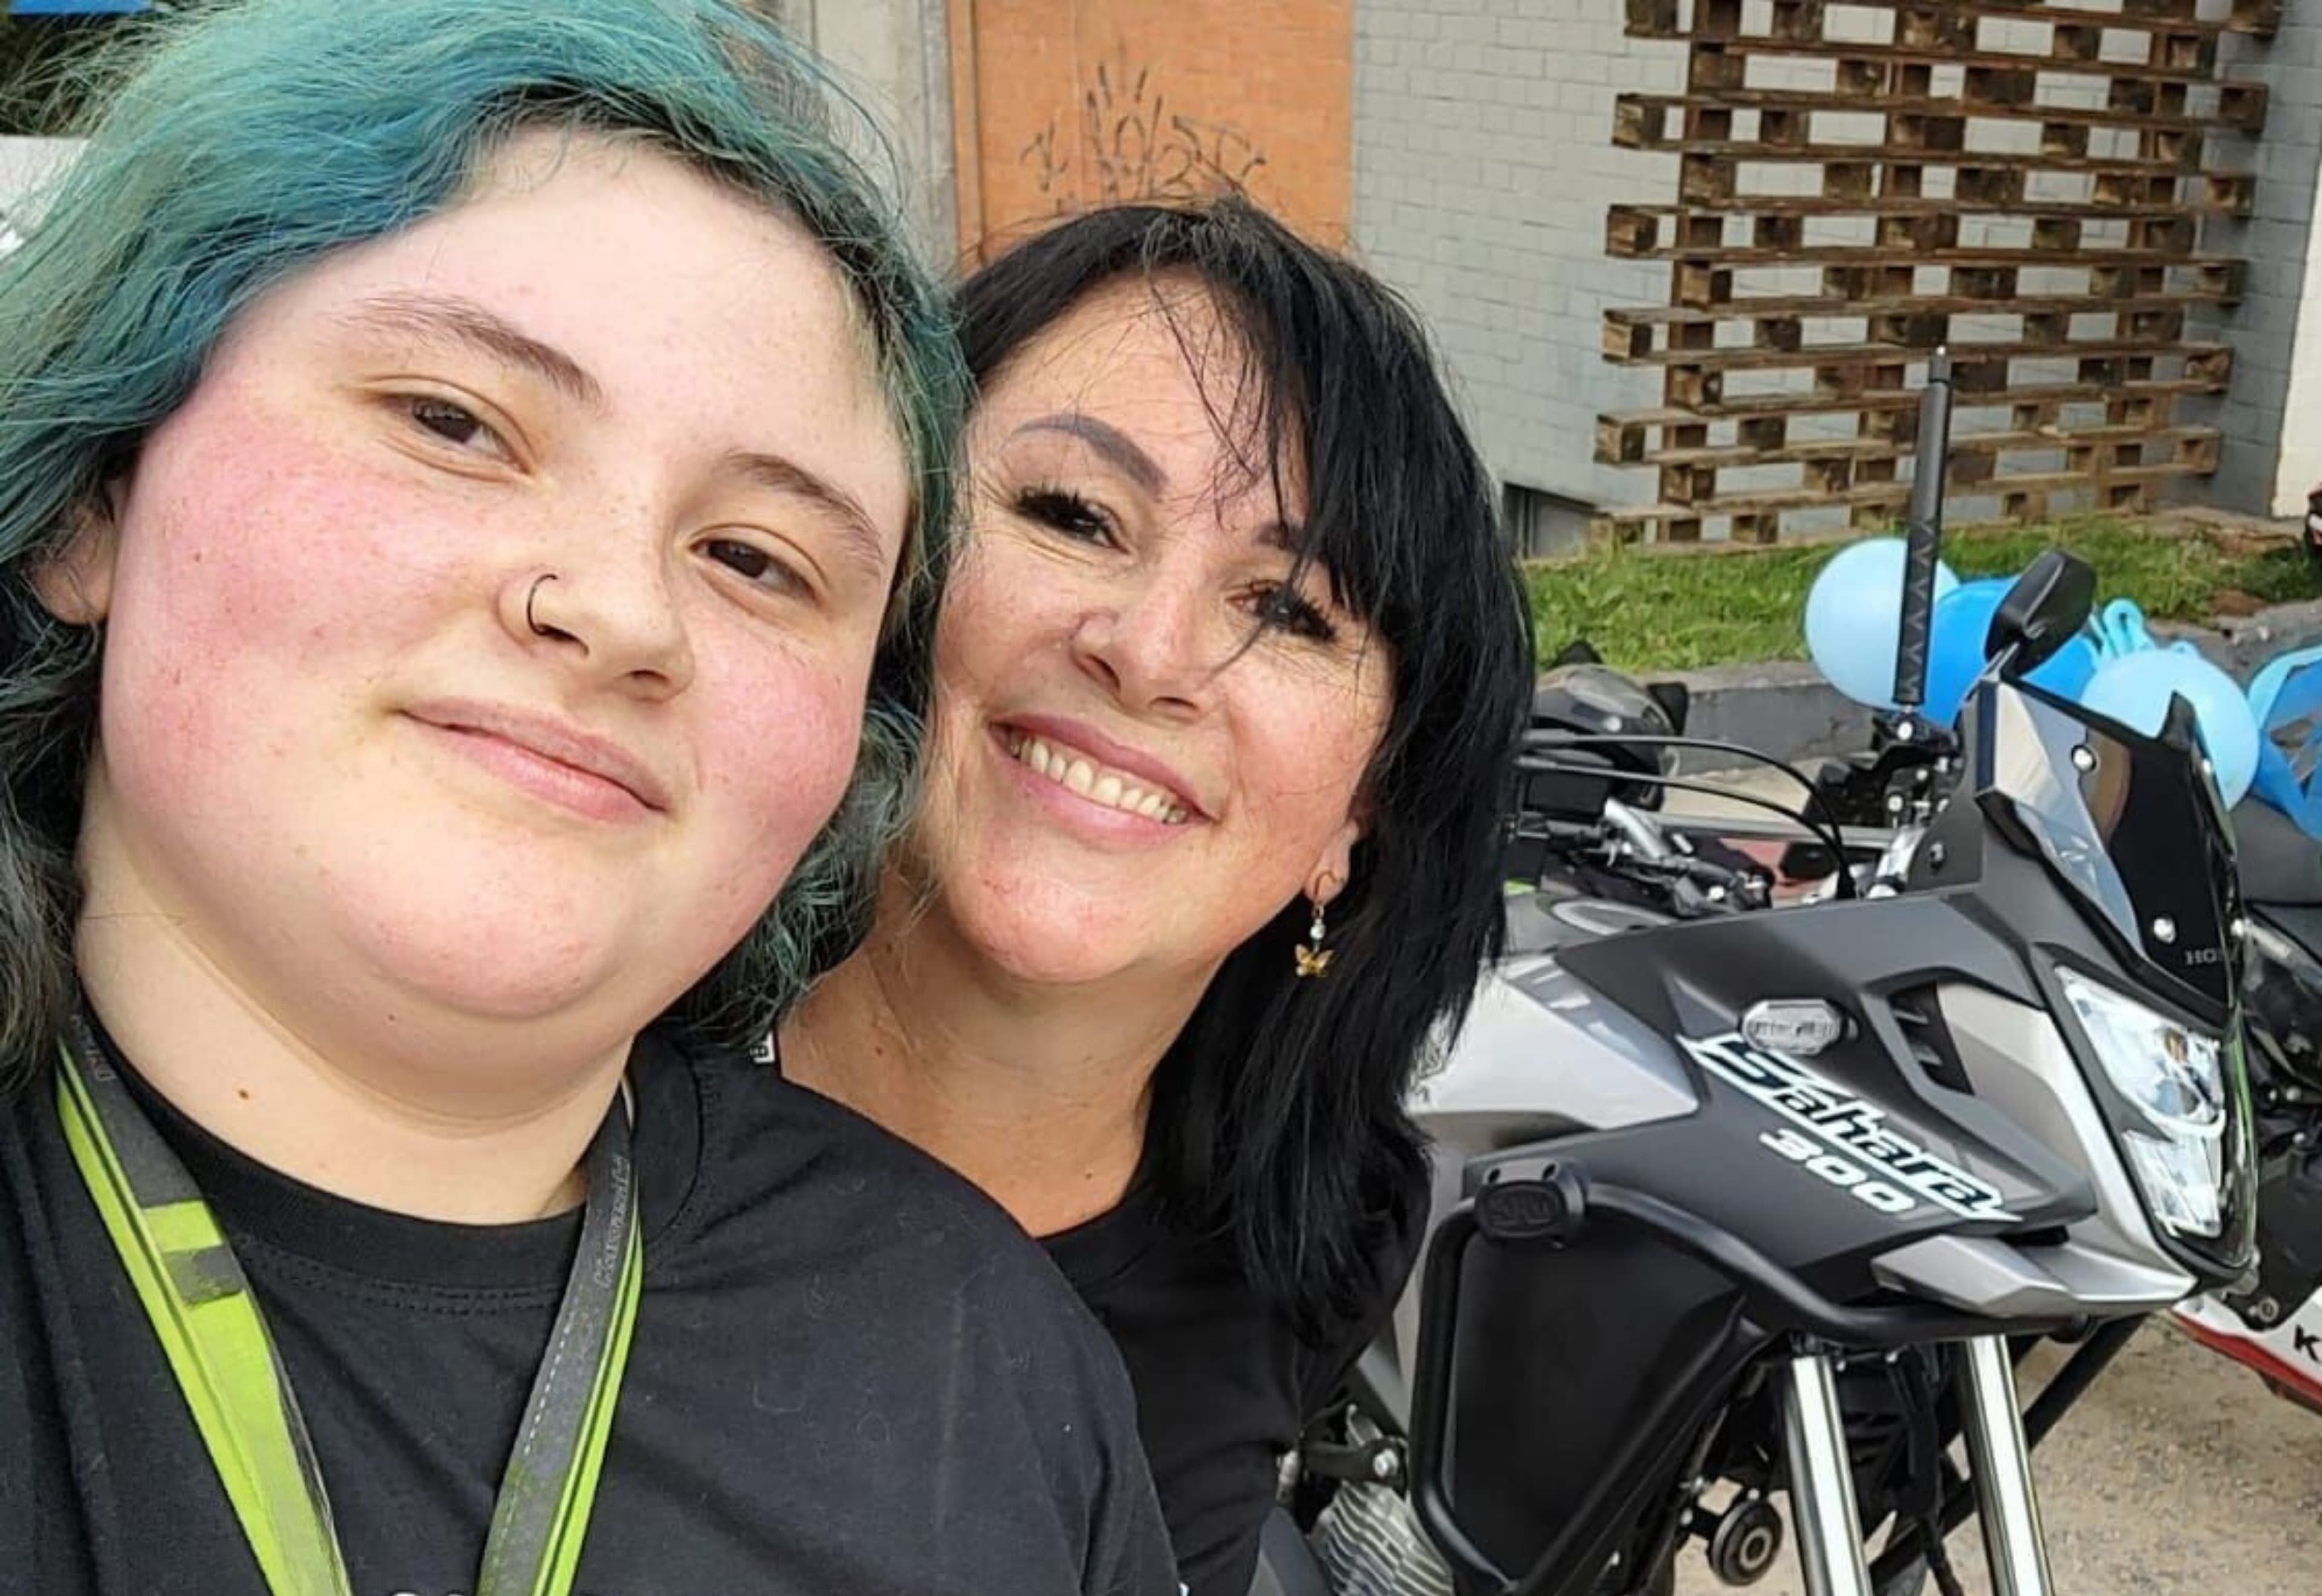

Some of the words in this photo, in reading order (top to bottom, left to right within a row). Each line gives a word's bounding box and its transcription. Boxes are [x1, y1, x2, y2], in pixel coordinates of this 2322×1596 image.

[2185, 947, 2220, 965] HO
[1677, 1033, 2021, 1221] Sahara
[1759, 1129, 1916, 1212] 300
